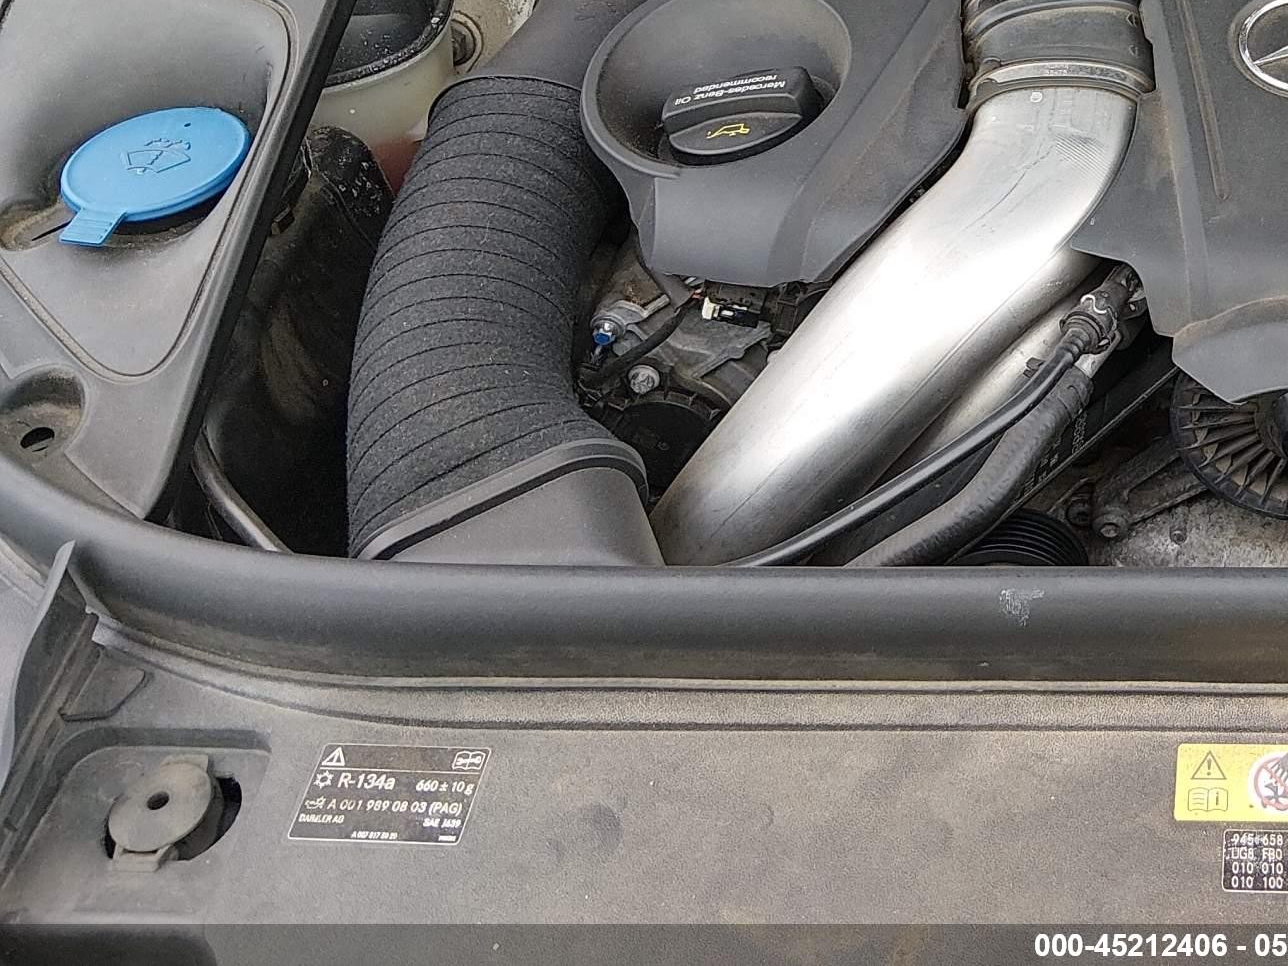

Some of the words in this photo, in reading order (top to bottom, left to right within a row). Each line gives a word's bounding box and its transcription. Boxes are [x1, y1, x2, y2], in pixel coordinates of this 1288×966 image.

[693, 74, 778, 94] recommended
[693, 81, 786, 101] Mercedes-Benz
[674, 96, 692, 106] Oil
[337, 772, 396, 790] R-134a
[416, 780, 437, 792] 660
[452, 780, 464, 792] 10
[464, 783, 475, 796] g
[327, 801, 337, 810] A
[340, 799, 362, 811] 001
[366, 800, 388, 812] 989
[391, 801, 407, 812] 08
[410, 801, 426, 813] 03
[428, 802, 462, 816] (PAG)
[423, 817, 440, 827] SAE
[1263, 834, 1283, 846] 658
[1232, 862, 1254, 874] 010
[1262, 862, 1284, 874] 010
[1232, 876, 1254, 888] 010
[1263, 876, 1283, 888] 100
